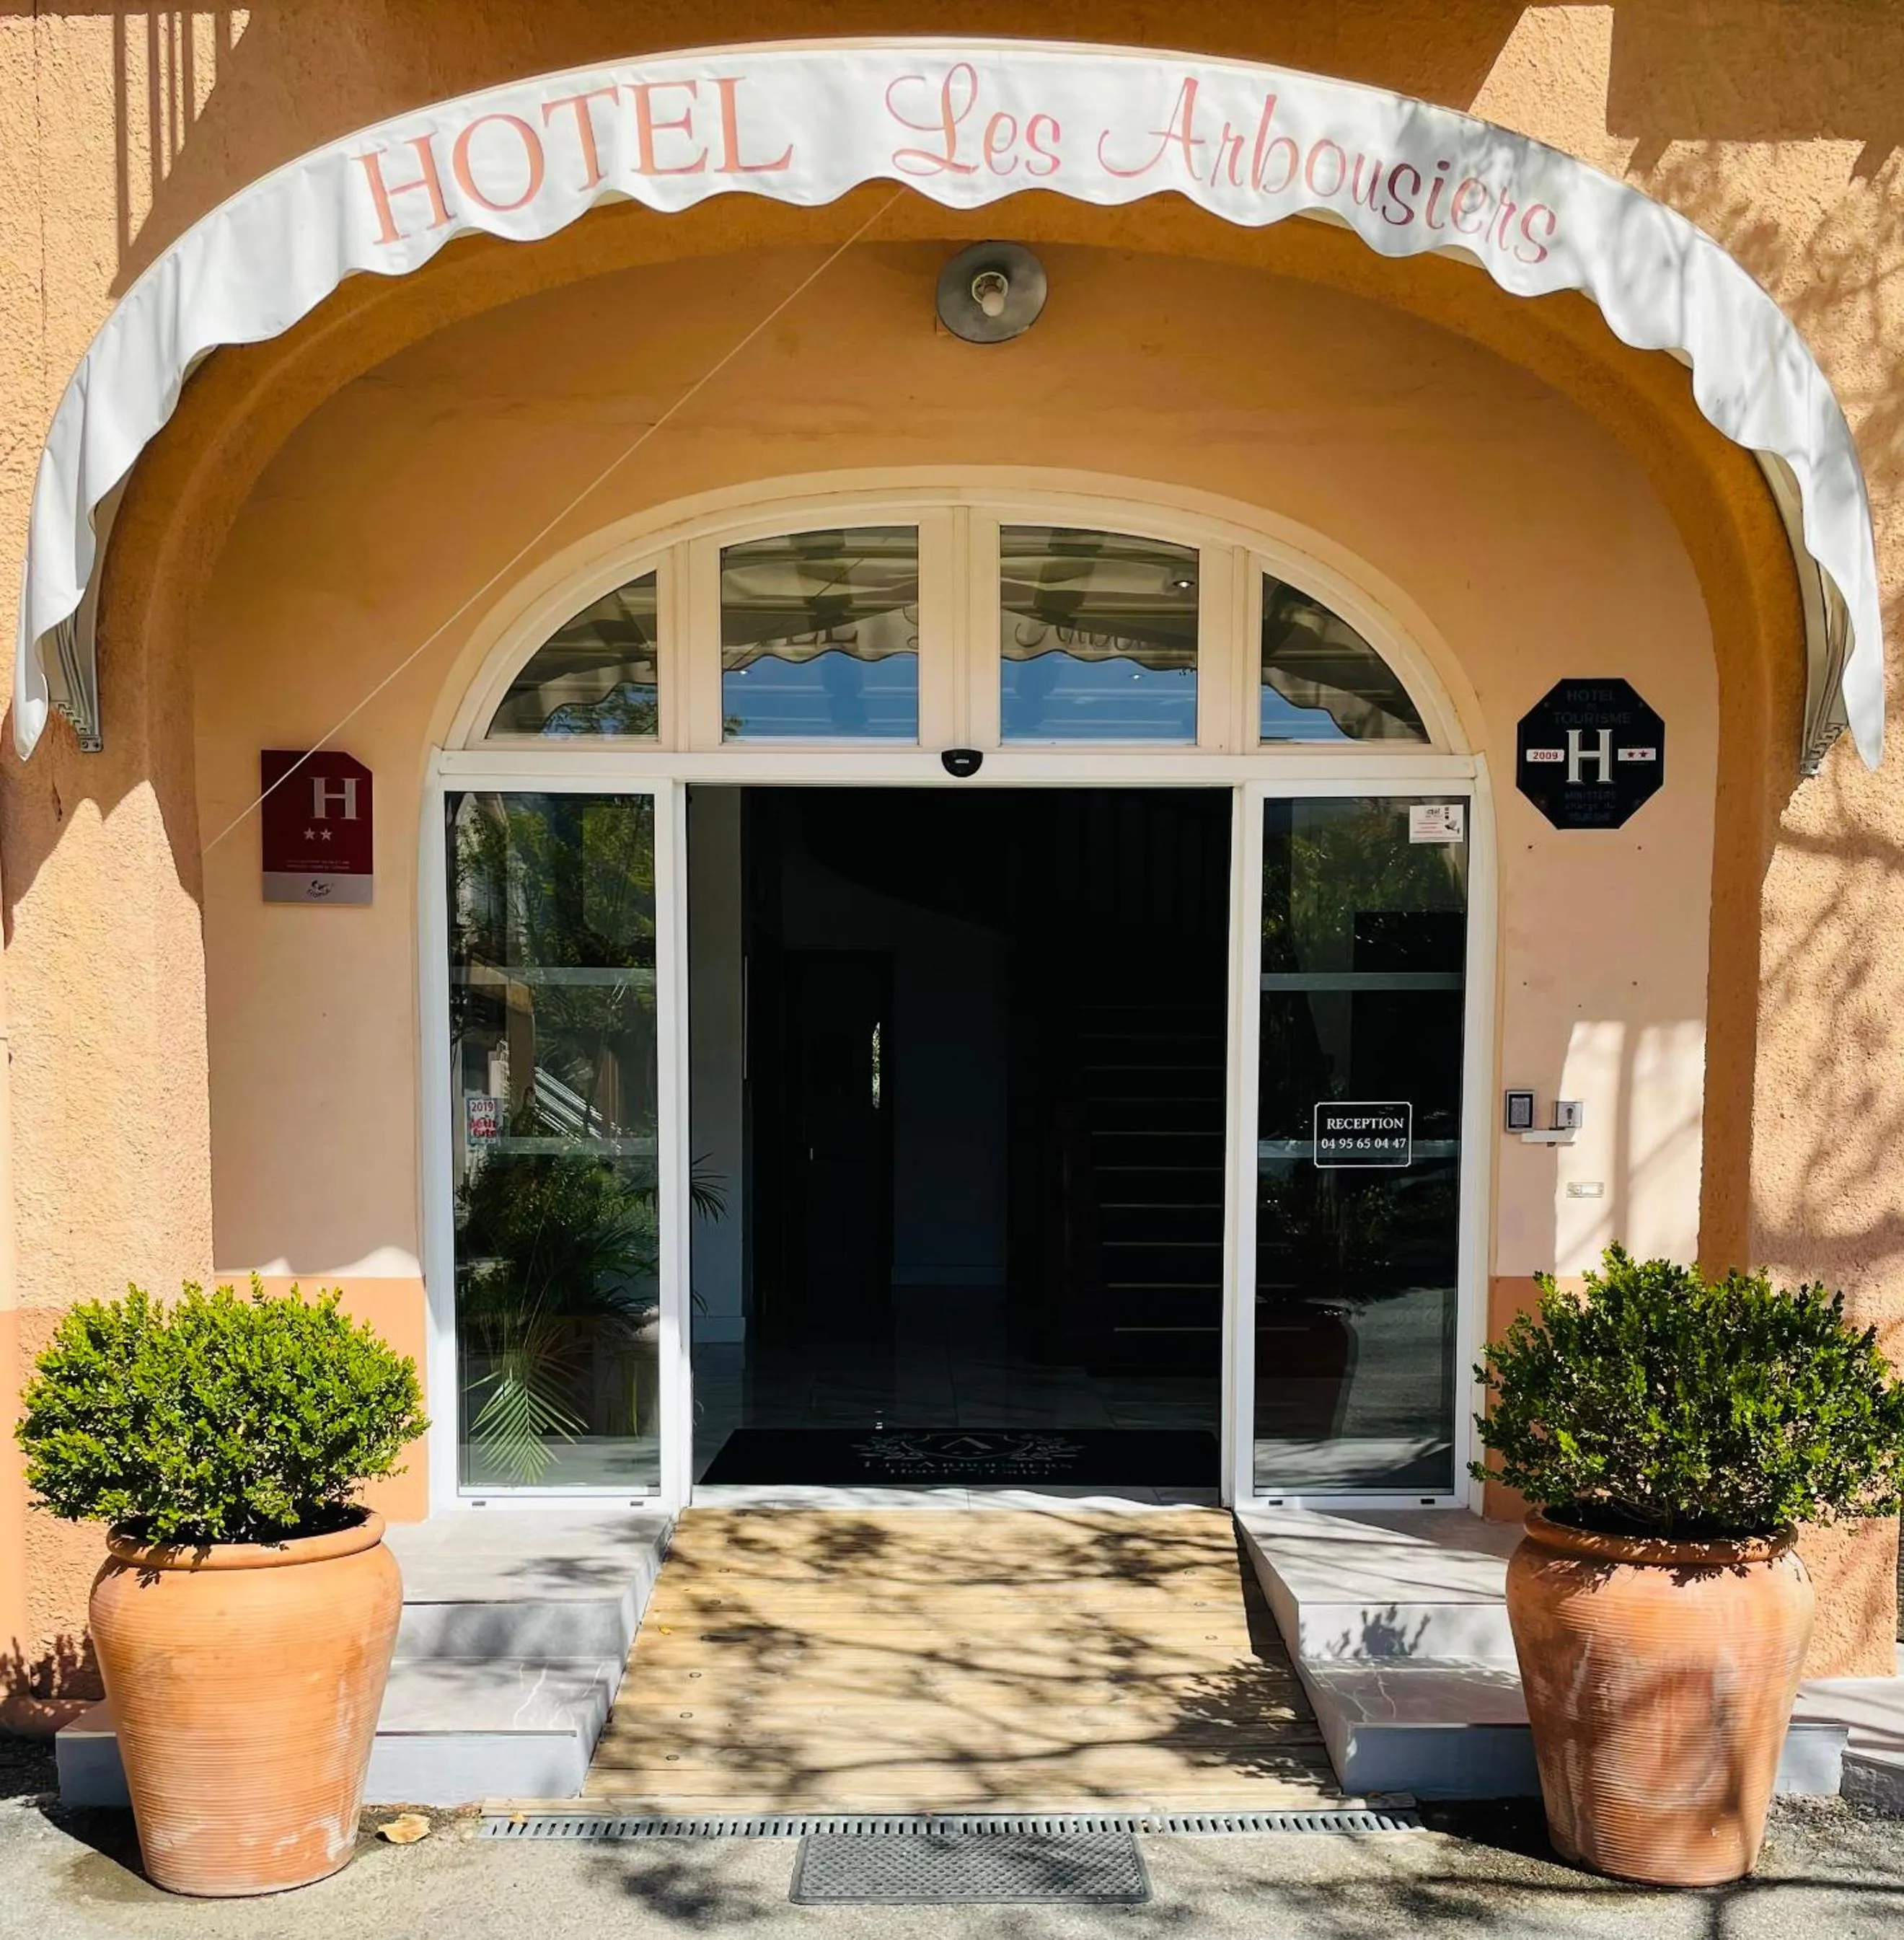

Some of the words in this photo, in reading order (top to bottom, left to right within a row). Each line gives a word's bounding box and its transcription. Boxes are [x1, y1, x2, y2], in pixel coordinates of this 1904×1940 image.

[350, 76, 793, 245] HOTEL
[886, 62, 1062, 178] Les
[1098, 76, 1557, 265] Arbousiers
[1566, 689, 1615, 702] HOTEL
[1552, 711, 1634, 725] TOURISME
[1532, 751, 1559, 761] 2009
[1566, 728, 1614, 783] H
[309, 777, 363, 820] H
[472, 1101, 494, 1112] 2019
[1326, 1118, 1404, 1130] RECEPTION
[1321, 1138, 1335, 1149] 04
[1339, 1138, 1353, 1149] 95
[1357, 1138, 1371, 1149] 65
[1375, 1138, 1389, 1149] 04
[1393, 1138, 1406, 1149] 47
